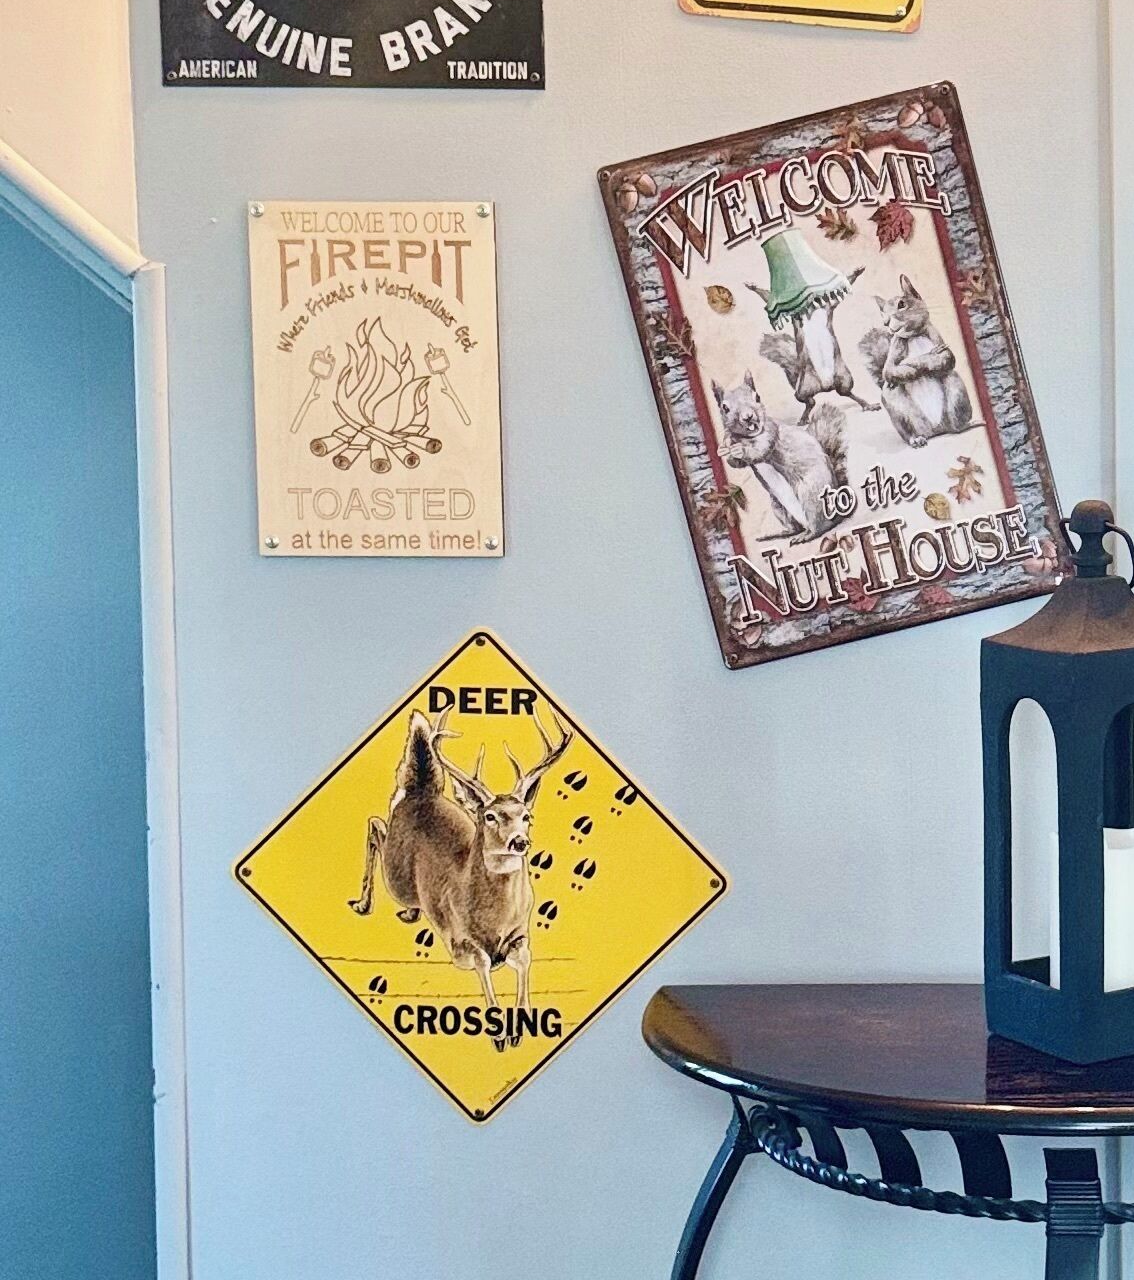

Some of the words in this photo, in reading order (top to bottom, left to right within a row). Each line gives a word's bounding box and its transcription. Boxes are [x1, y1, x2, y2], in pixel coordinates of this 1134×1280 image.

[178, 60, 258, 80] AMERICAN
[447, 61, 529, 81] TRADITION
[280, 211, 385, 234] WELCOME
[392, 211, 418, 234] TO
[423, 211, 466, 234] OUR
[638, 148, 952, 279] WELCOME
[277, 238, 473, 312] FIREPIT
[277, 315, 310, 353] Where
[305, 281, 355, 317] Friends
[375, 277, 458, 328] Marshmallows
[454, 326, 478, 353] Get
[288, 487, 476, 521] TOASTED
[820, 488, 855, 519] to
[860, 465, 921, 509] the
[291, 531, 316, 550] at
[318, 529, 353, 550] the
[361, 533, 423, 551] same
[428, 529, 482, 550] time!
[726, 547, 852, 627] NUT
[851, 504, 1041, 594] HOUSE
[428, 686, 537, 716] DEER
[393, 1004, 563, 1038] CROSSING
